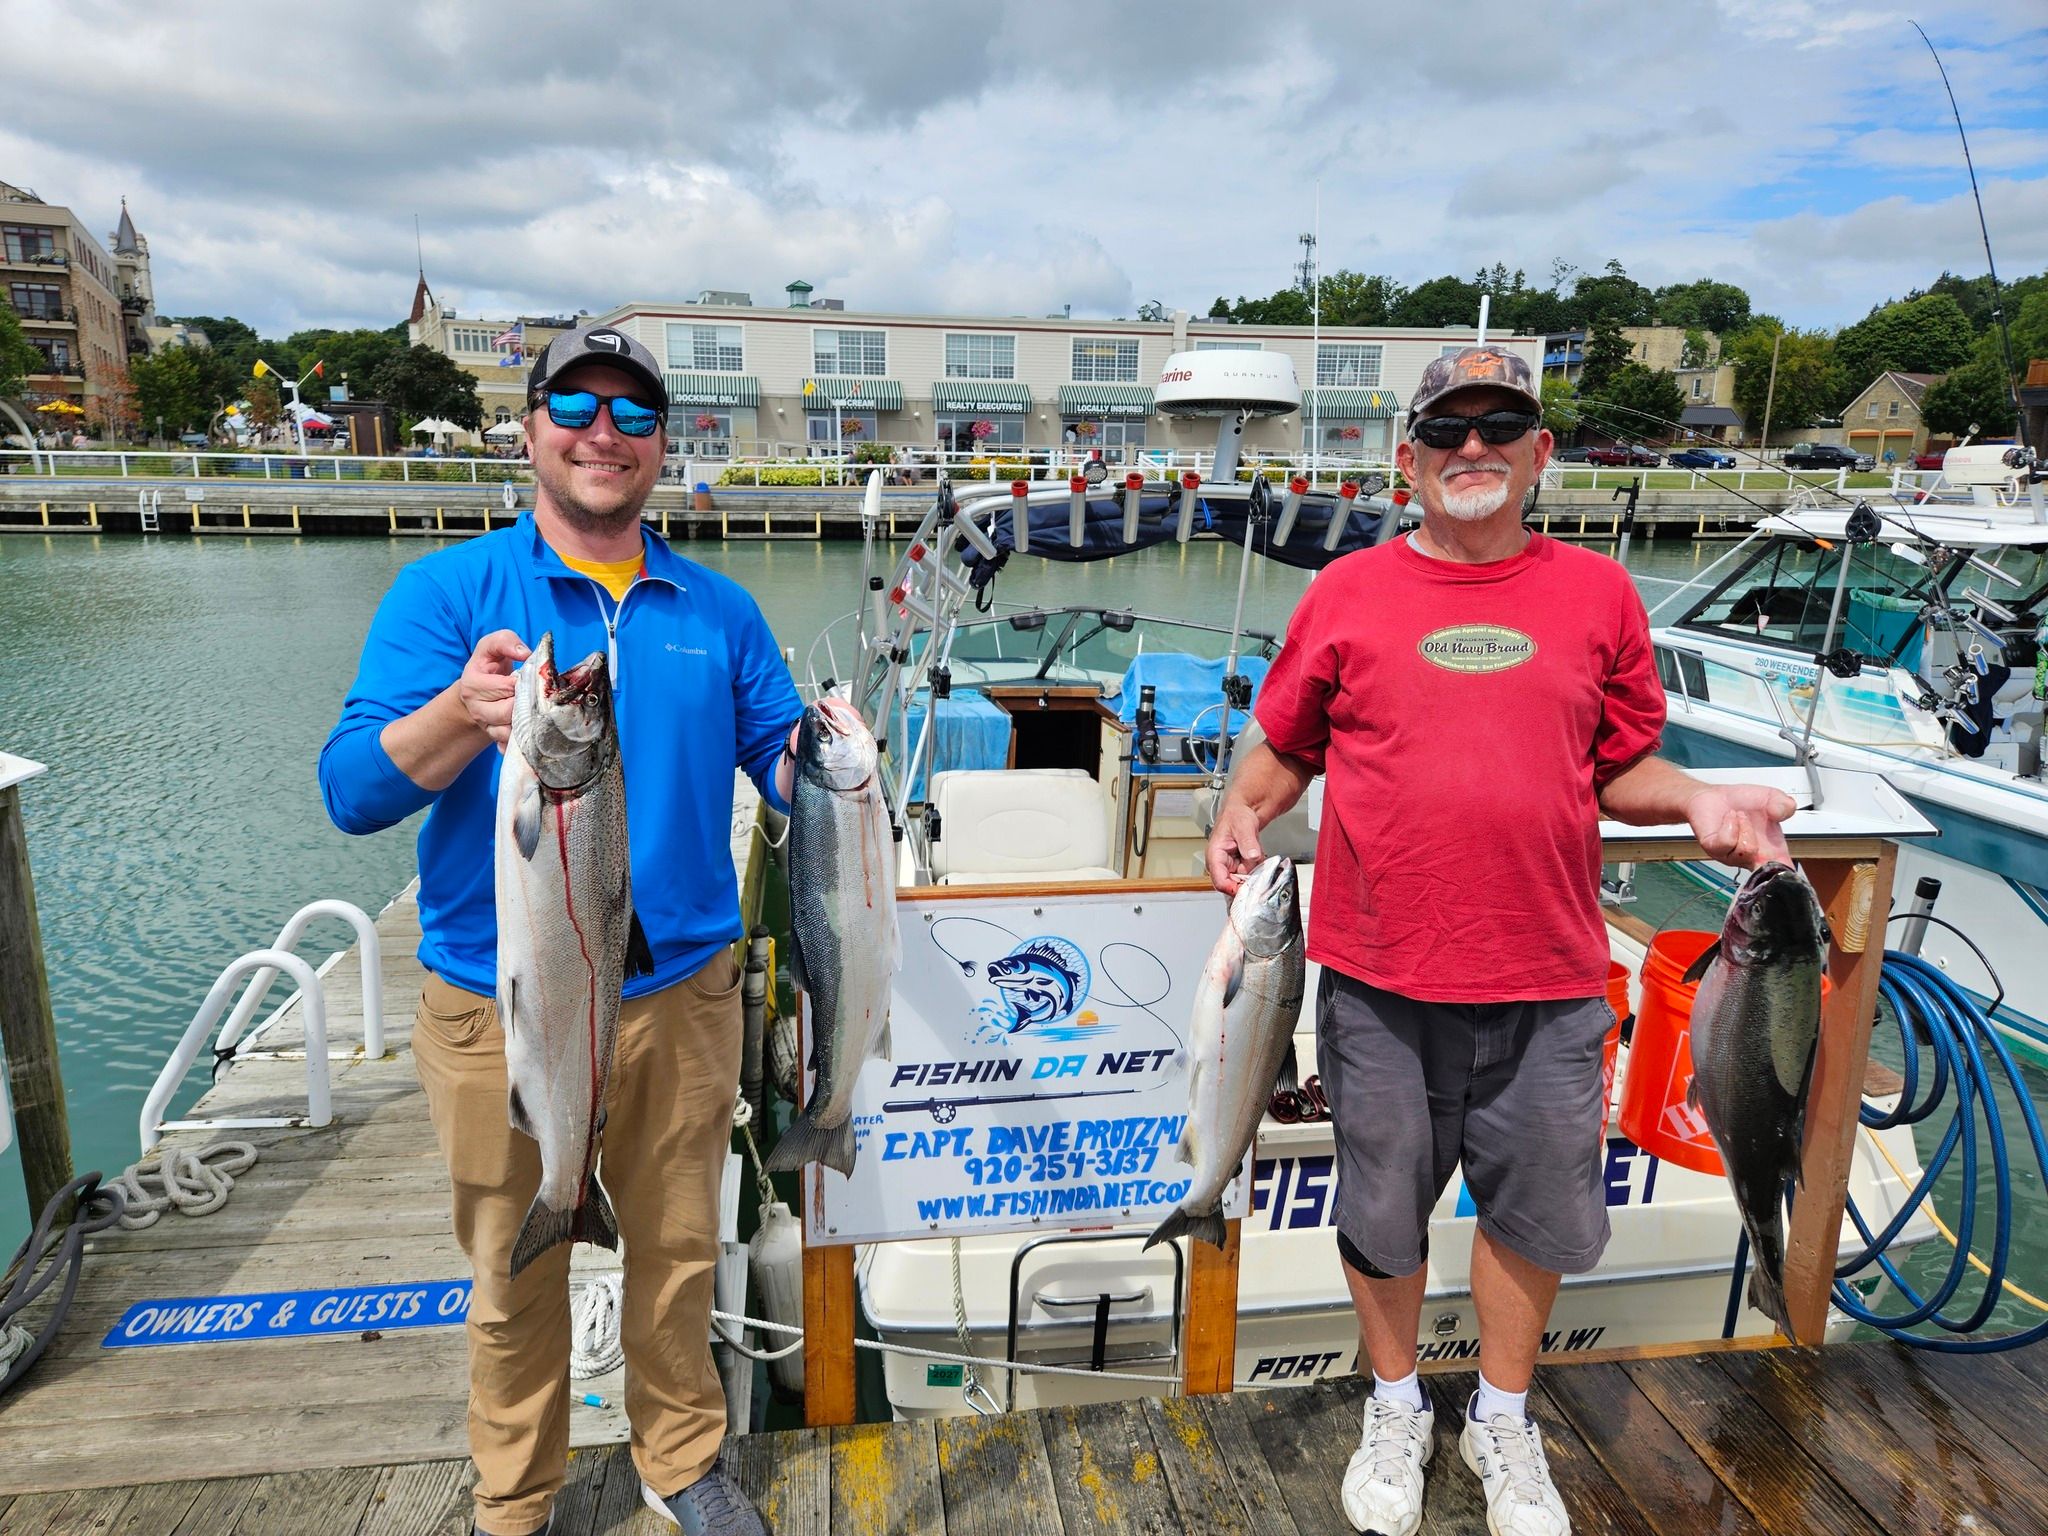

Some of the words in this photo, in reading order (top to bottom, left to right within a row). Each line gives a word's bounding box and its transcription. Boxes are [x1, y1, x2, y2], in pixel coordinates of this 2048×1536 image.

[676, 394, 718, 402] DOCKSIDE
[946, 401, 976, 410] REALTY
[976, 402, 1024, 411] EXECUTIVES
[1077, 404, 1110, 413] LOCALLY
[1110, 405, 1145, 413] INSPIRED
[673, 644, 707, 655] Columbia
[1424, 642, 1449, 653] Old
[1452, 642, 1484, 656] Navy
[1485, 642, 1530, 653] Brand
[890, 1058, 1023, 1088] FISHIN
[1031, 1054, 1089, 1080] DA
[1096, 1048, 1176, 1076] NET
[881, 1127, 974, 1161] CAPT.
[986, 1121, 1071, 1155] DAVE
[964, 1146, 1160, 1186] 920-254-3137
[1602, 1136, 1659, 1207] ET
[1253, 1155, 1338, 1231] FIS
[124, 1301, 263, 1338] OWNERS
[269, 1299, 297, 1328] &
[309, 1290, 428, 1326] GUESTS
[932, 1370, 960, 1379] 2027
[1247, 1351, 1343, 1383] PORT
[1563, 1326, 1607, 1352] WI
